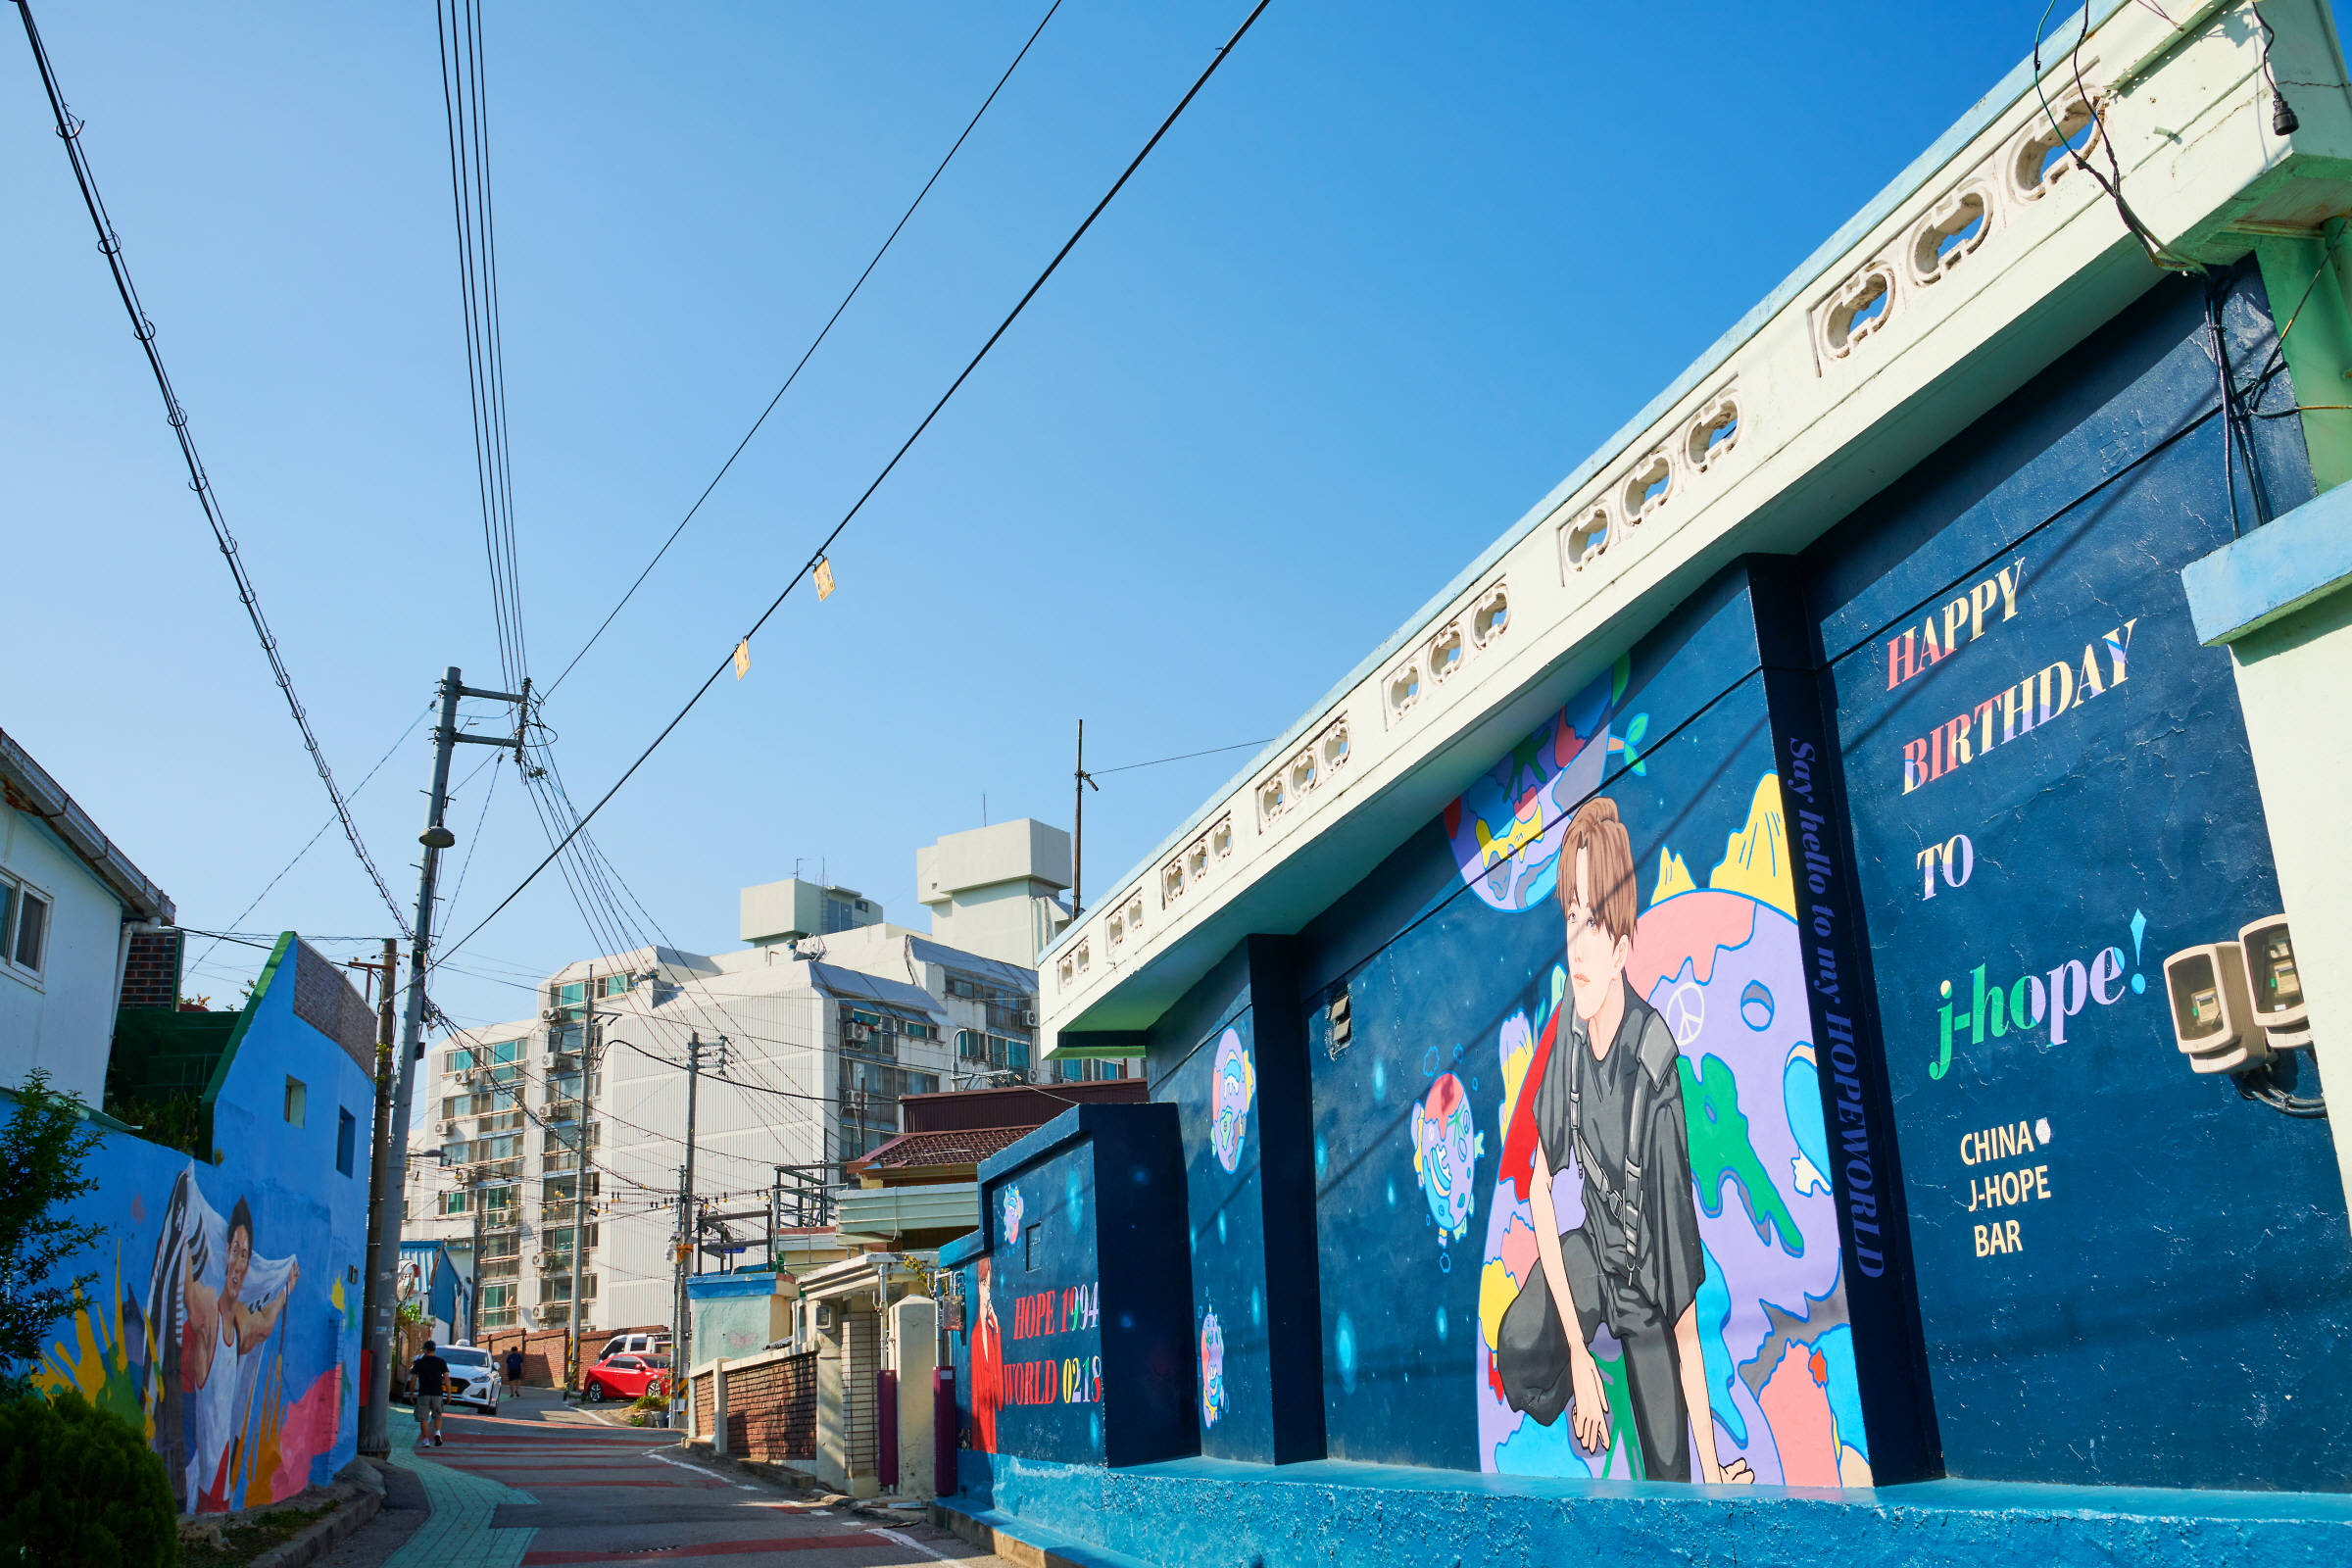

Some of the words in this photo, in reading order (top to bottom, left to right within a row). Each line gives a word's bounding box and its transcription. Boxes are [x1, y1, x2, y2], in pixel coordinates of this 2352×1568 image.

[1886, 556, 2026, 692] HAPPY
[1901, 617, 2137, 796] BIRTHDAY
[1787, 736, 1817, 804] Say
[1799, 808, 1833, 895] hello
[1916, 833, 1974, 902] TO
[1811, 904, 1836, 938] to
[1813, 946, 1841, 1004] my
[1929, 907, 2147, 1080] j-hope!
[1825, 1009, 1885, 1279] HOPEWORLD
[1959, 1120, 2035, 1166] CHINA
[1968, 1164, 2052, 1212] J-HOPE
[1973, 1219, 2024, 1258] BAR
[1012, 1290, 1056, 1340] HOPE
[1059, 1281, 1099, 1333] 1994
[1003, 1359, 1057, 1406] WORLD
[1062, 1355, 1102, 1404] 0218
